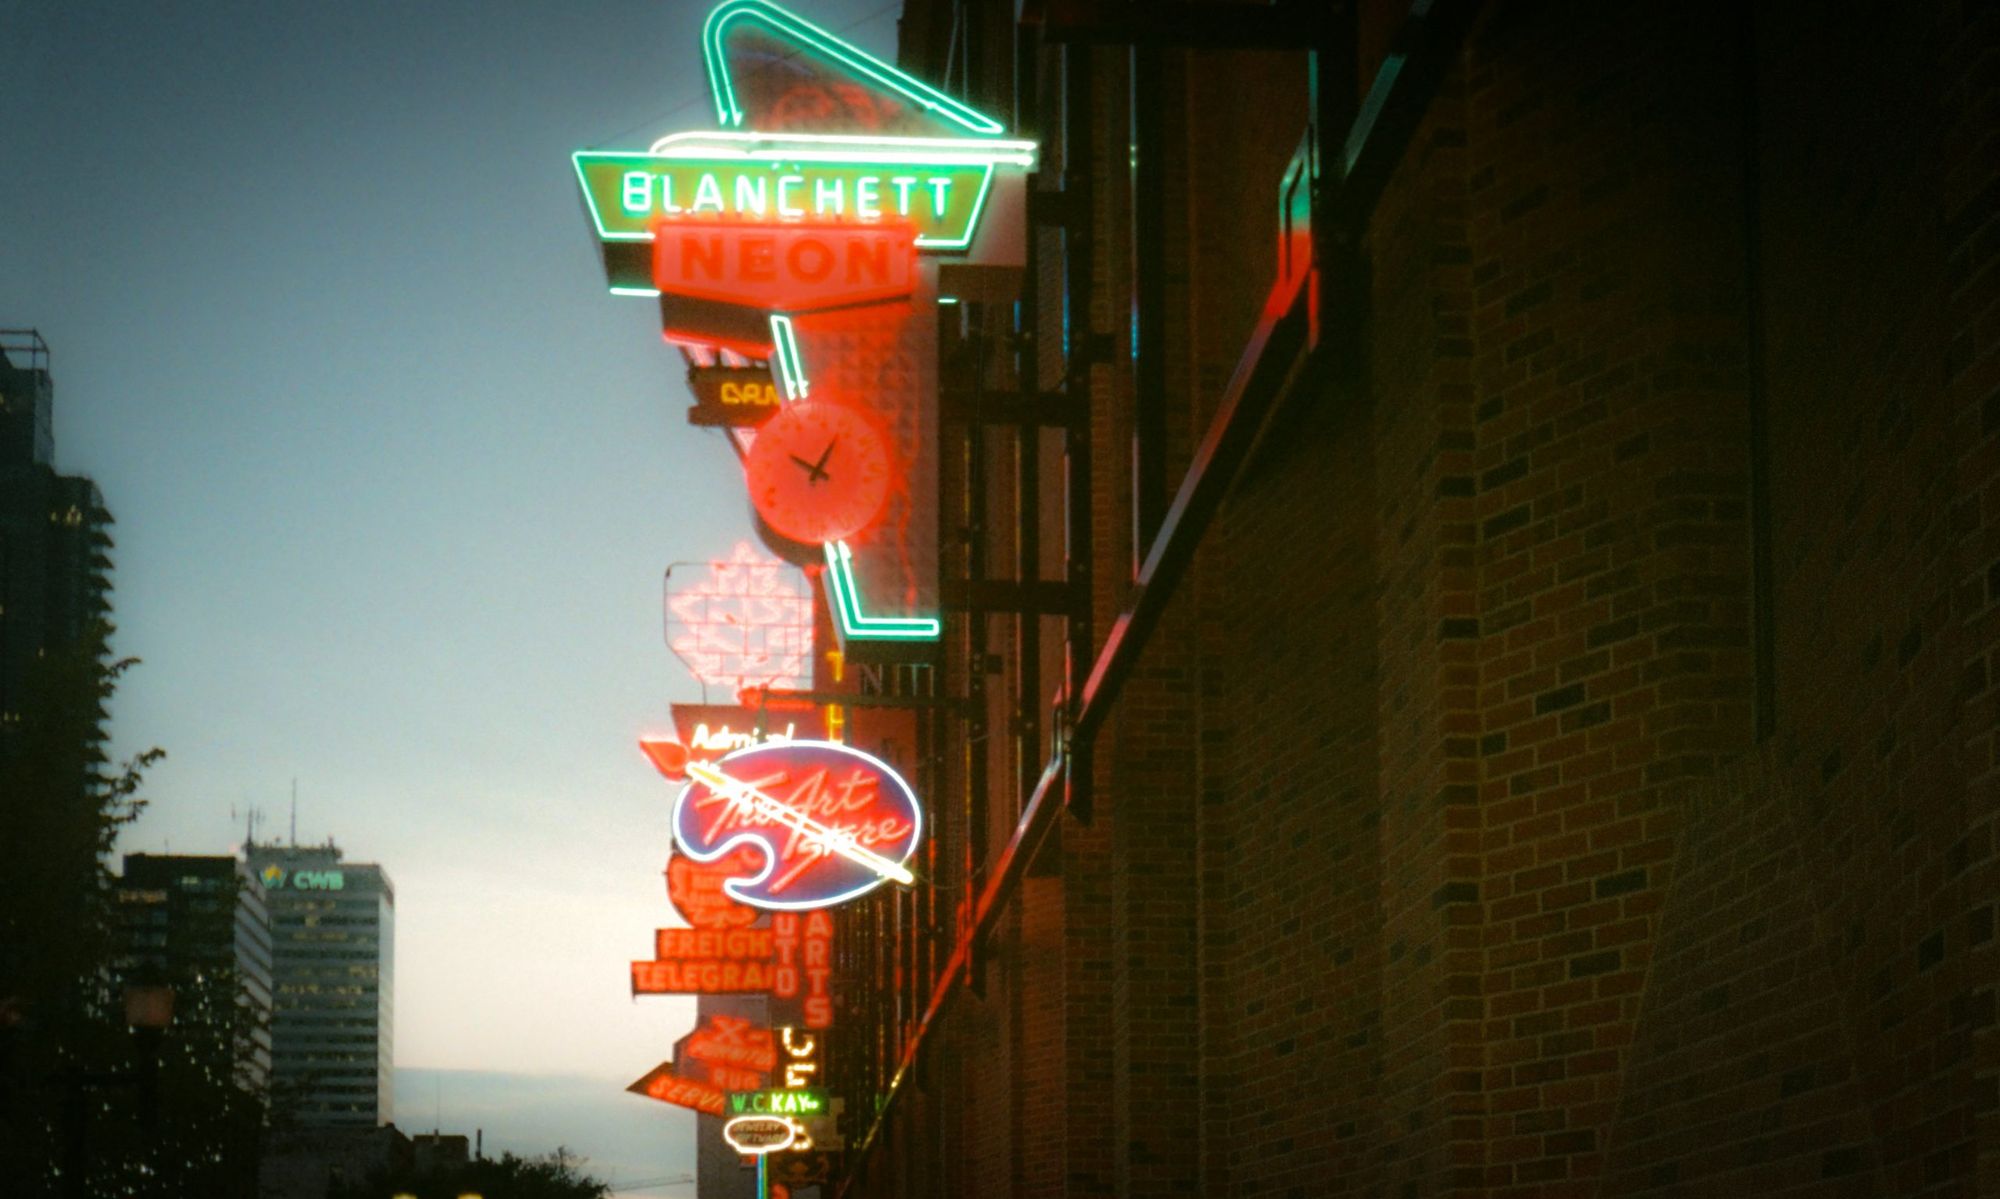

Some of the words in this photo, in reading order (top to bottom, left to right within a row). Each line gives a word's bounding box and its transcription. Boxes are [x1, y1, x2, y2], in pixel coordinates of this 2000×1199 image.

[621, 171, 952, 218] BLANCHETT
[680, 235, 889, 282] NEON
[293, 869, 344, 890] CWB
[633, 962, 773, 989] TELEGRA
